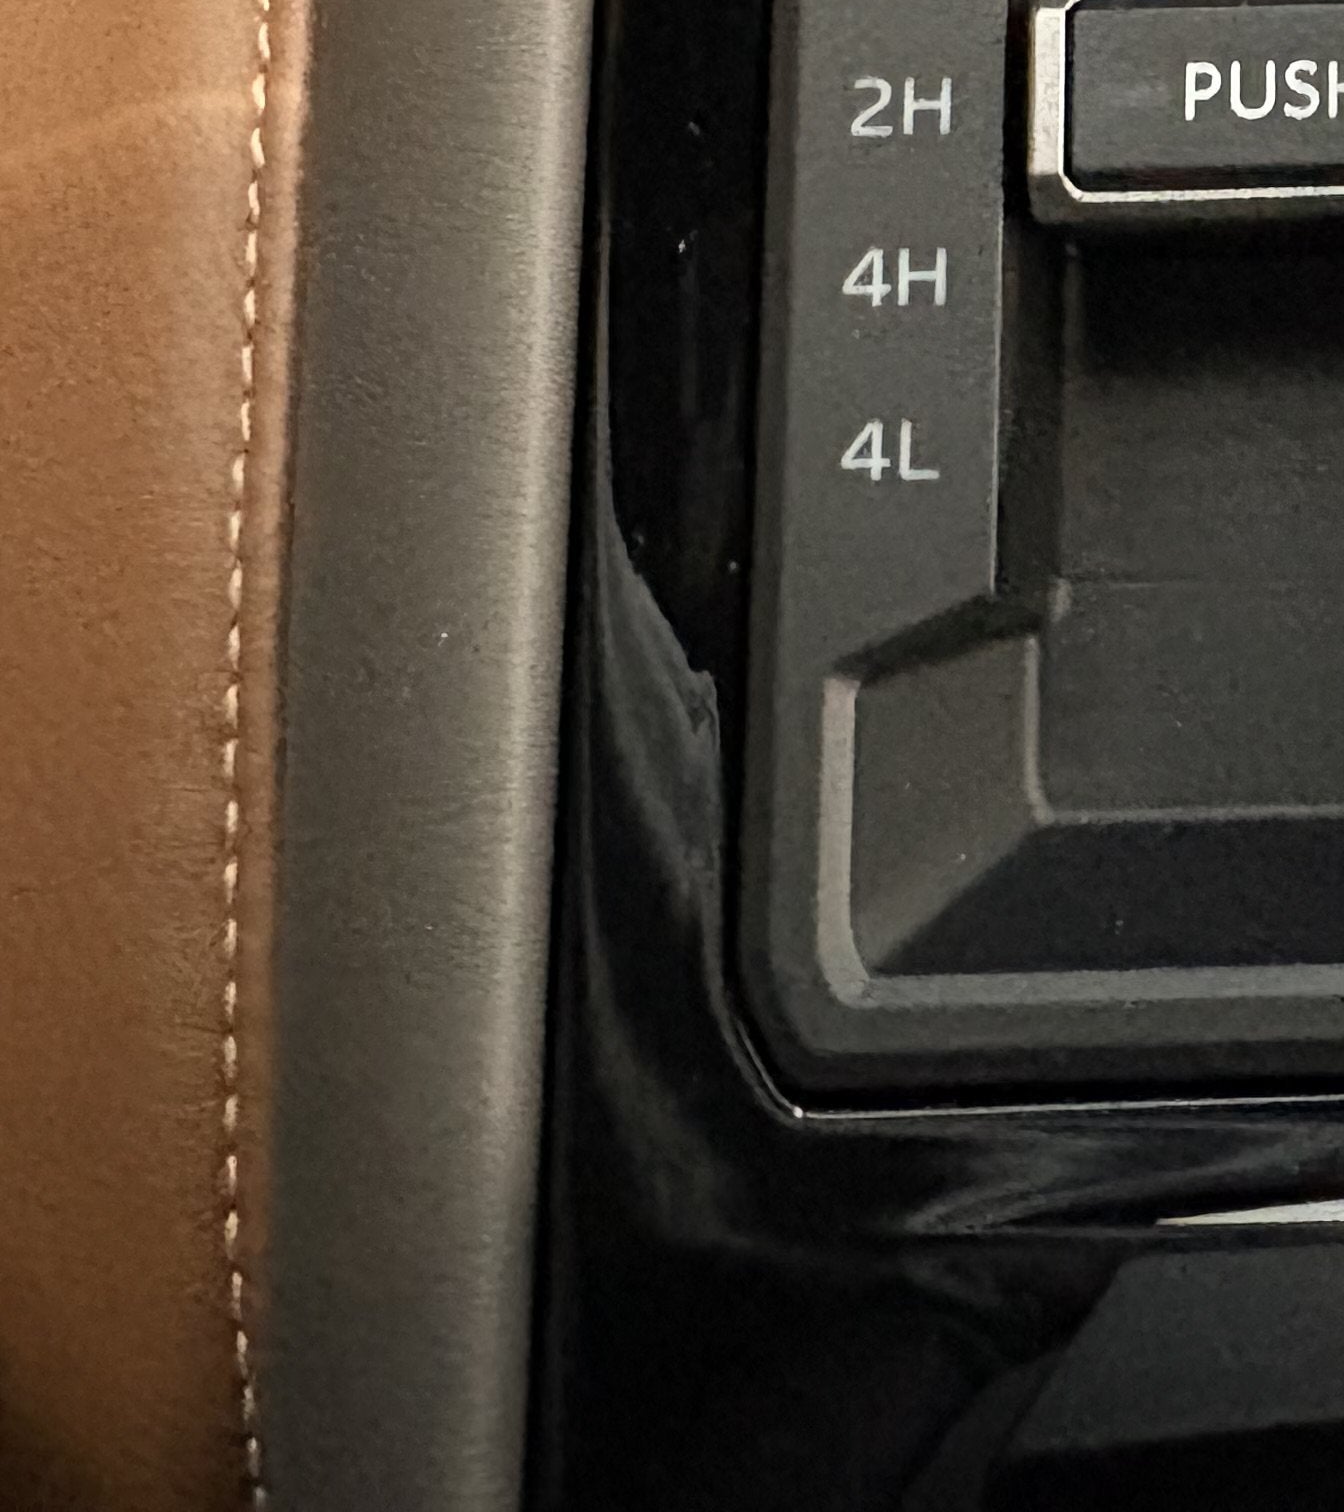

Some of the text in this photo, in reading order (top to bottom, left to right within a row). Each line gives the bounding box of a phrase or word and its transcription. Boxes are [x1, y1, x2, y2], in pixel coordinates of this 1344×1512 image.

[850, 75, 953, 137] 2H
[841, 246, 947, 307] 4H
[839, 418, 941, 481] 4L
